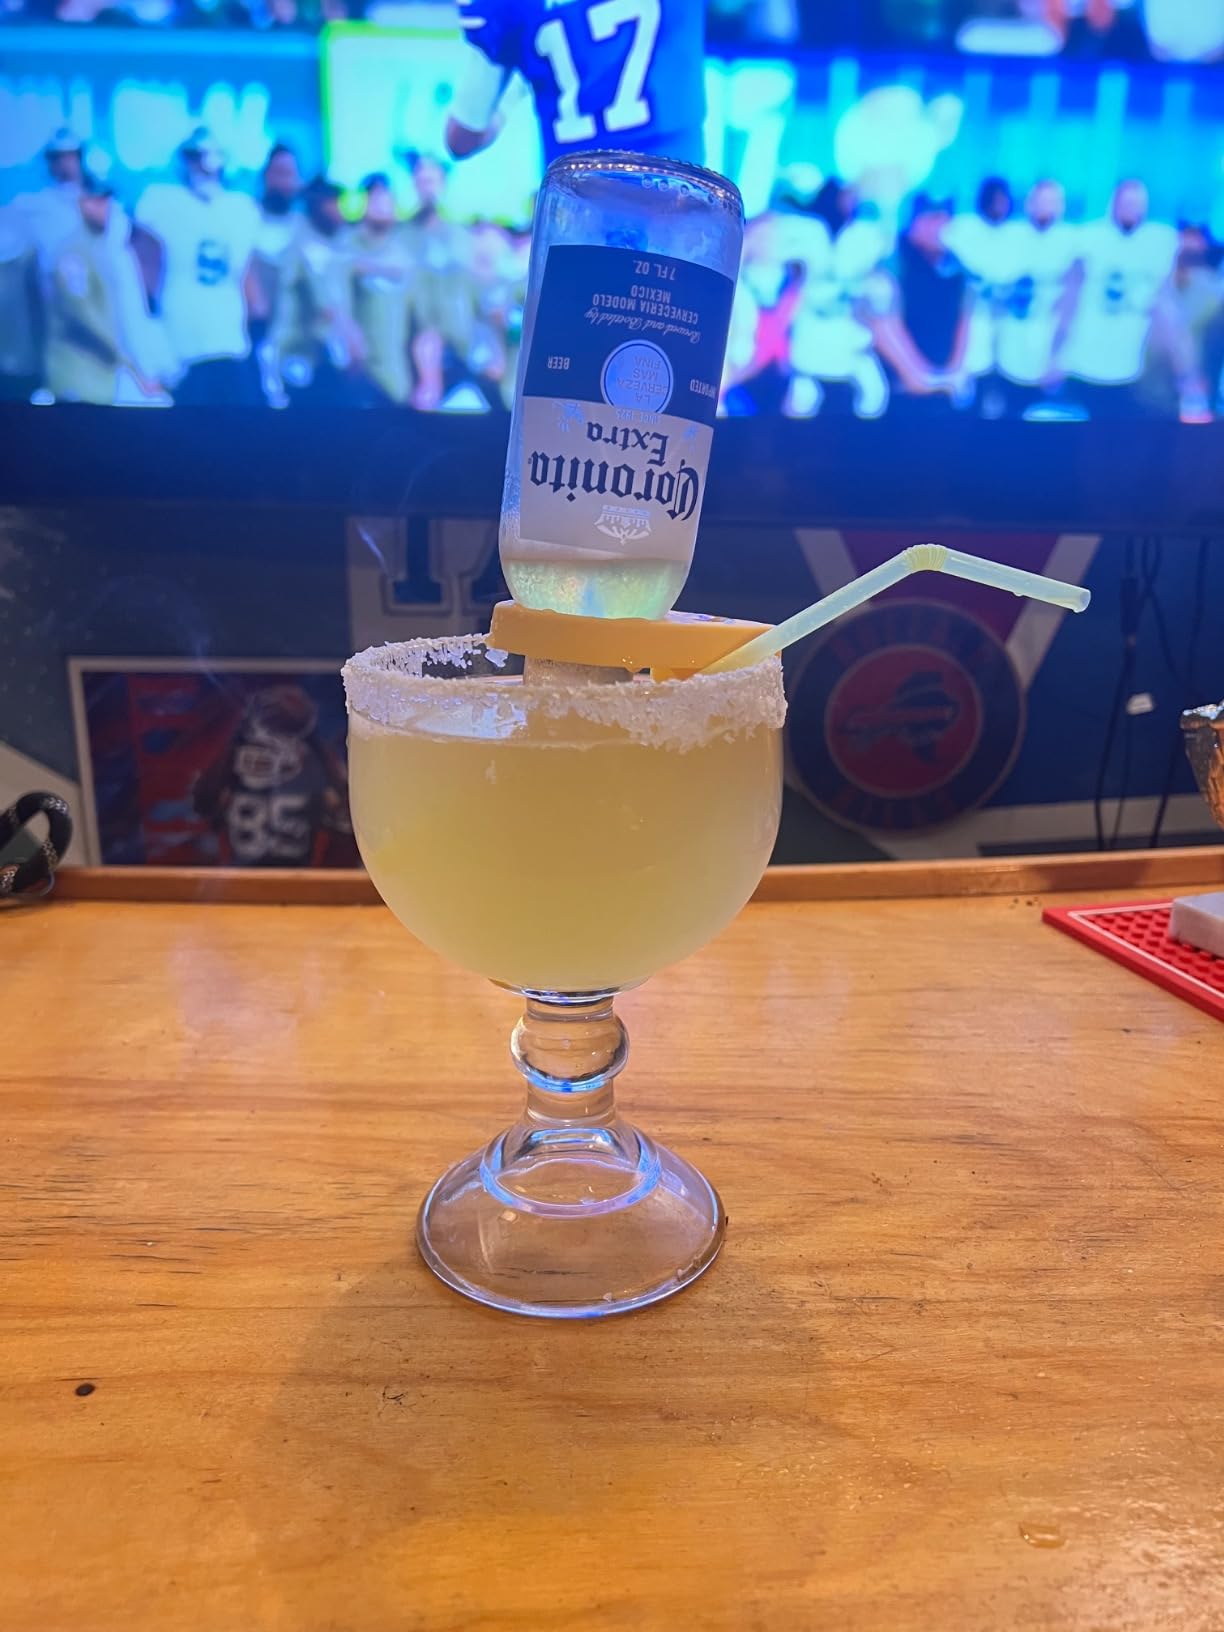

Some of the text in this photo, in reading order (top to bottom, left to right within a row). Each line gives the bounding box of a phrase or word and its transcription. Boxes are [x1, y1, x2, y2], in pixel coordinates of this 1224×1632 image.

[534, 0, 661, 143] 17
[669, 266, 677, 281] 7
[630, 284, 672, 303] MEXICO
[592, 293, 699, 325] CERVECERIA MODELO
[583, 306, 702, 344] Brewed and Bottled by
[547, 356, 571, 370] BEER
[634, 356, 662, 370] FINA
[635, 392, 651, 405] LA
[586, 420, 669, 467] Extra
[529, 450, 699, 521] Coronita
